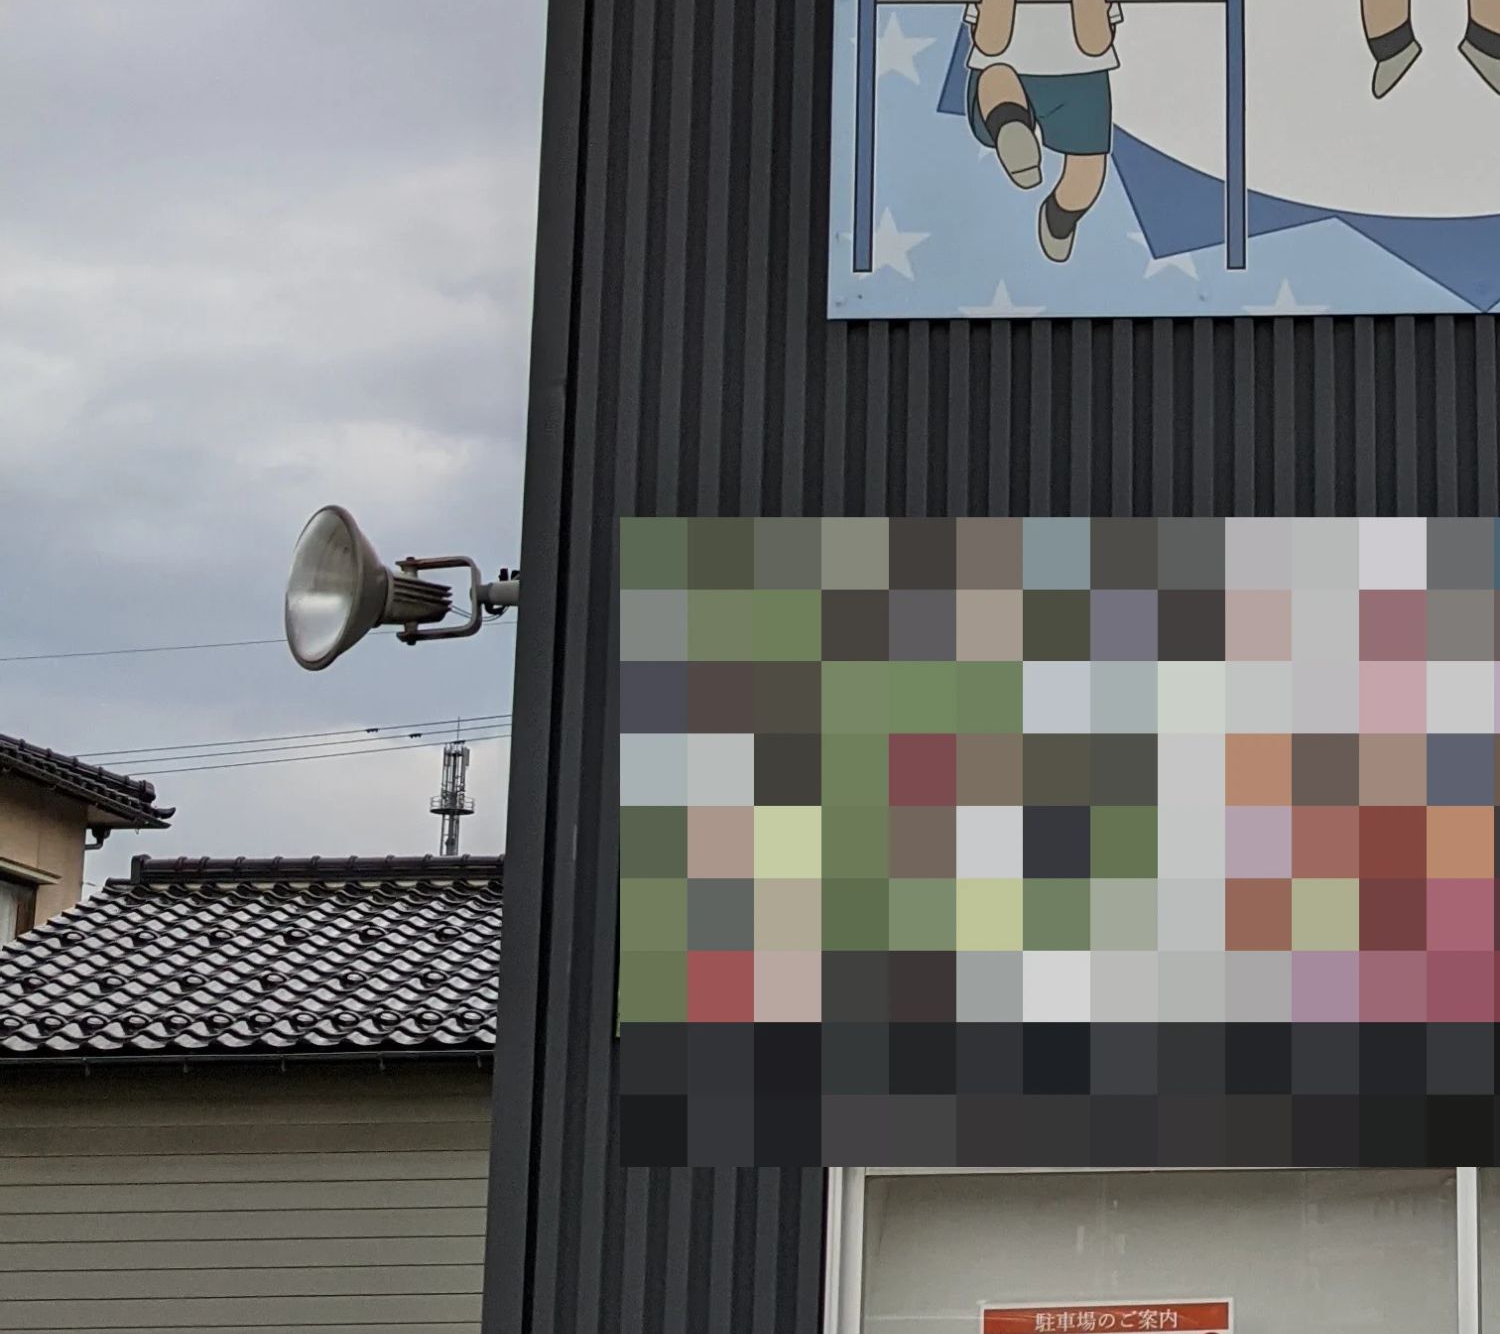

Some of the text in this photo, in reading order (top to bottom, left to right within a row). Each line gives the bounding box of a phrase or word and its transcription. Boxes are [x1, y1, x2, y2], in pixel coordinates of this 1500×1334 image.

[1035, 1309, 1178, 1333] 駐車場のご案内
